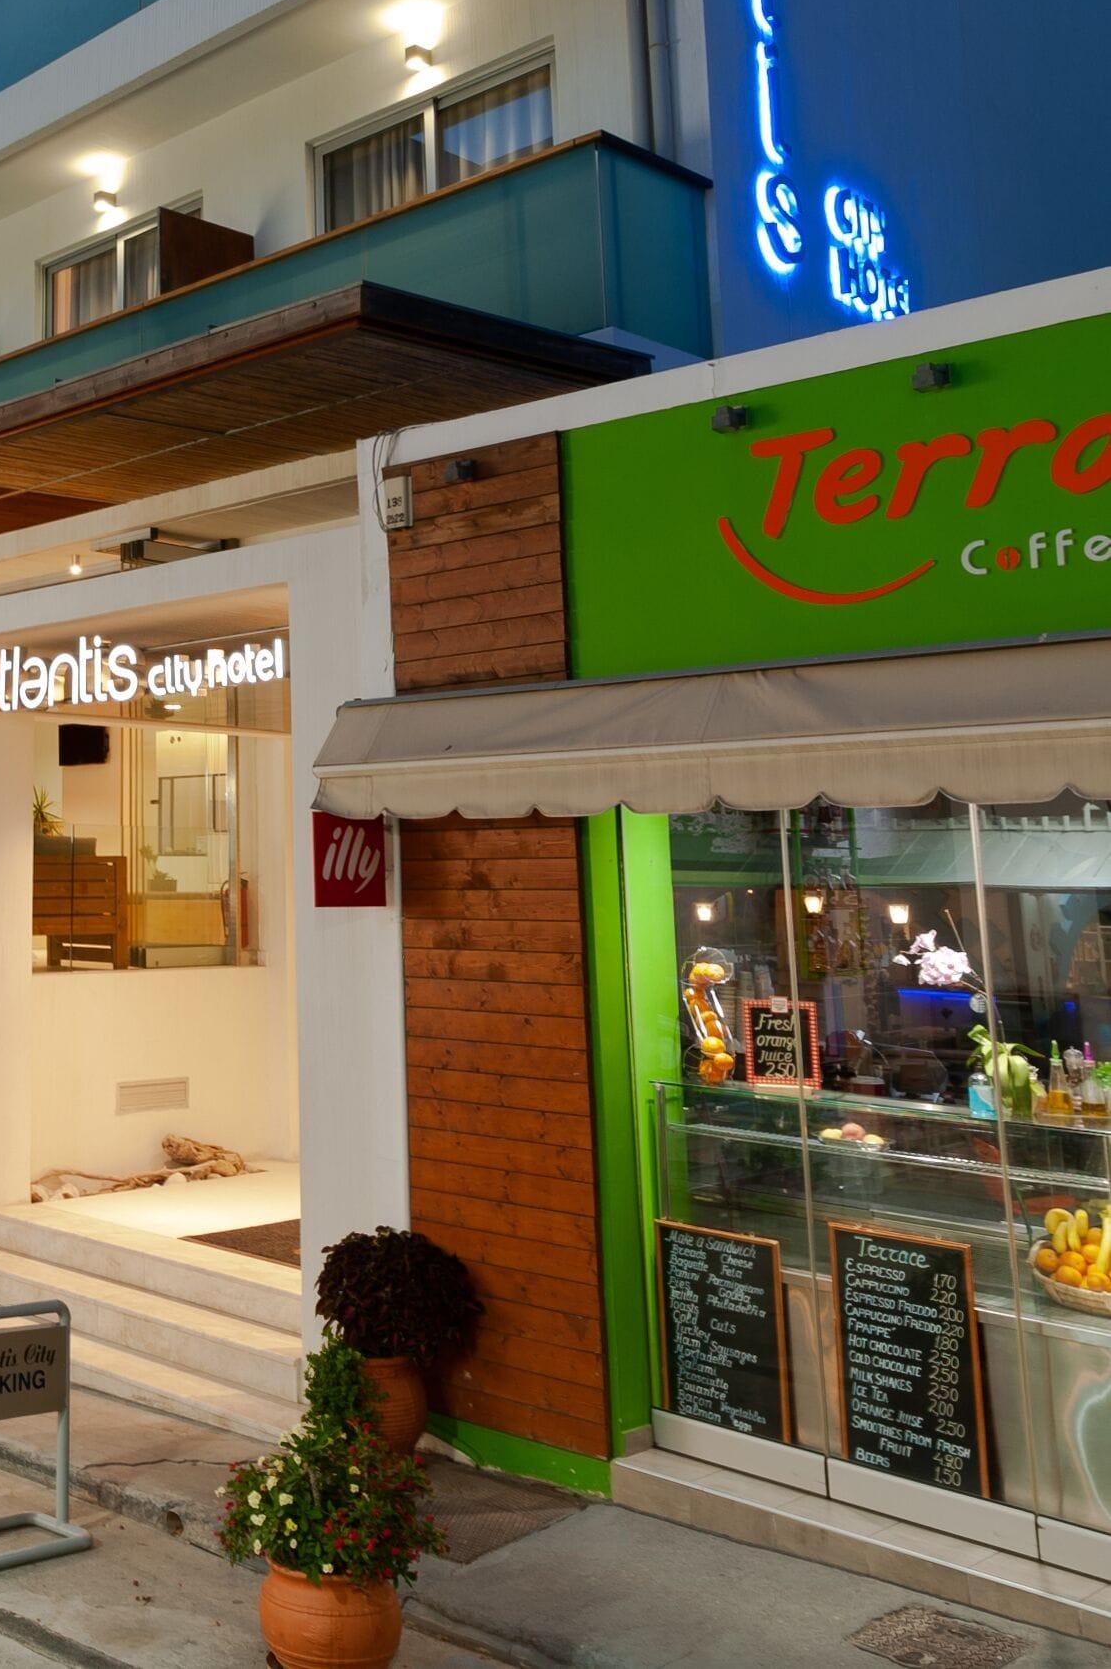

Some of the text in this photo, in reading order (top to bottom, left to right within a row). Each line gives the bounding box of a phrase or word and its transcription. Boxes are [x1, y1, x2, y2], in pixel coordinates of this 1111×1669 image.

[322, 825, 381, 894] illy
[756, 1034, 797, 1051] orang
[696, 1237, 704, 1248] a
[705, 1237, 756, 1259] Sandwich
[853, 1235, 931, 1269] Terrace
[720, 1253, 754, 1270] Cheese
[720, 1264, 743, 1279] Feta
[845, 1257, 906, 1282] ESPRESSO
[845, 1273, 910, 1297] CAPPUCCINO
[845, 1287, 896, 1310] ESPRESSO
[898, 1299, 938, 1319] FREDDO
[672, 1310, 737, 1335] Cold Cuts
[845, 1303, 903, 1326] CAPPUCCINO
[904, 1315, 942, 1334] FREDDO
[23, 1343, 58, 1370] City
[709, 1340, 758, 1365] Sausages
[847, 1333, 868, 1349] HOT
[869, 1339, 923, 1361] CHOCOLATE
[849, 1349, 870, 1365] COLD
[871, 1355, 923, 1377] CHOCOLATE
[870, 1385, 889, 1403] TEA
[851, 1398, 895, 1422] ORANGE
[879, 1437, 913, 1457] FRUIT
[904, 1429, 933, 1448] FROM
[936, 1439, 971, 1459] FRESH
[855, 1447, 891, 1468] BEERS
